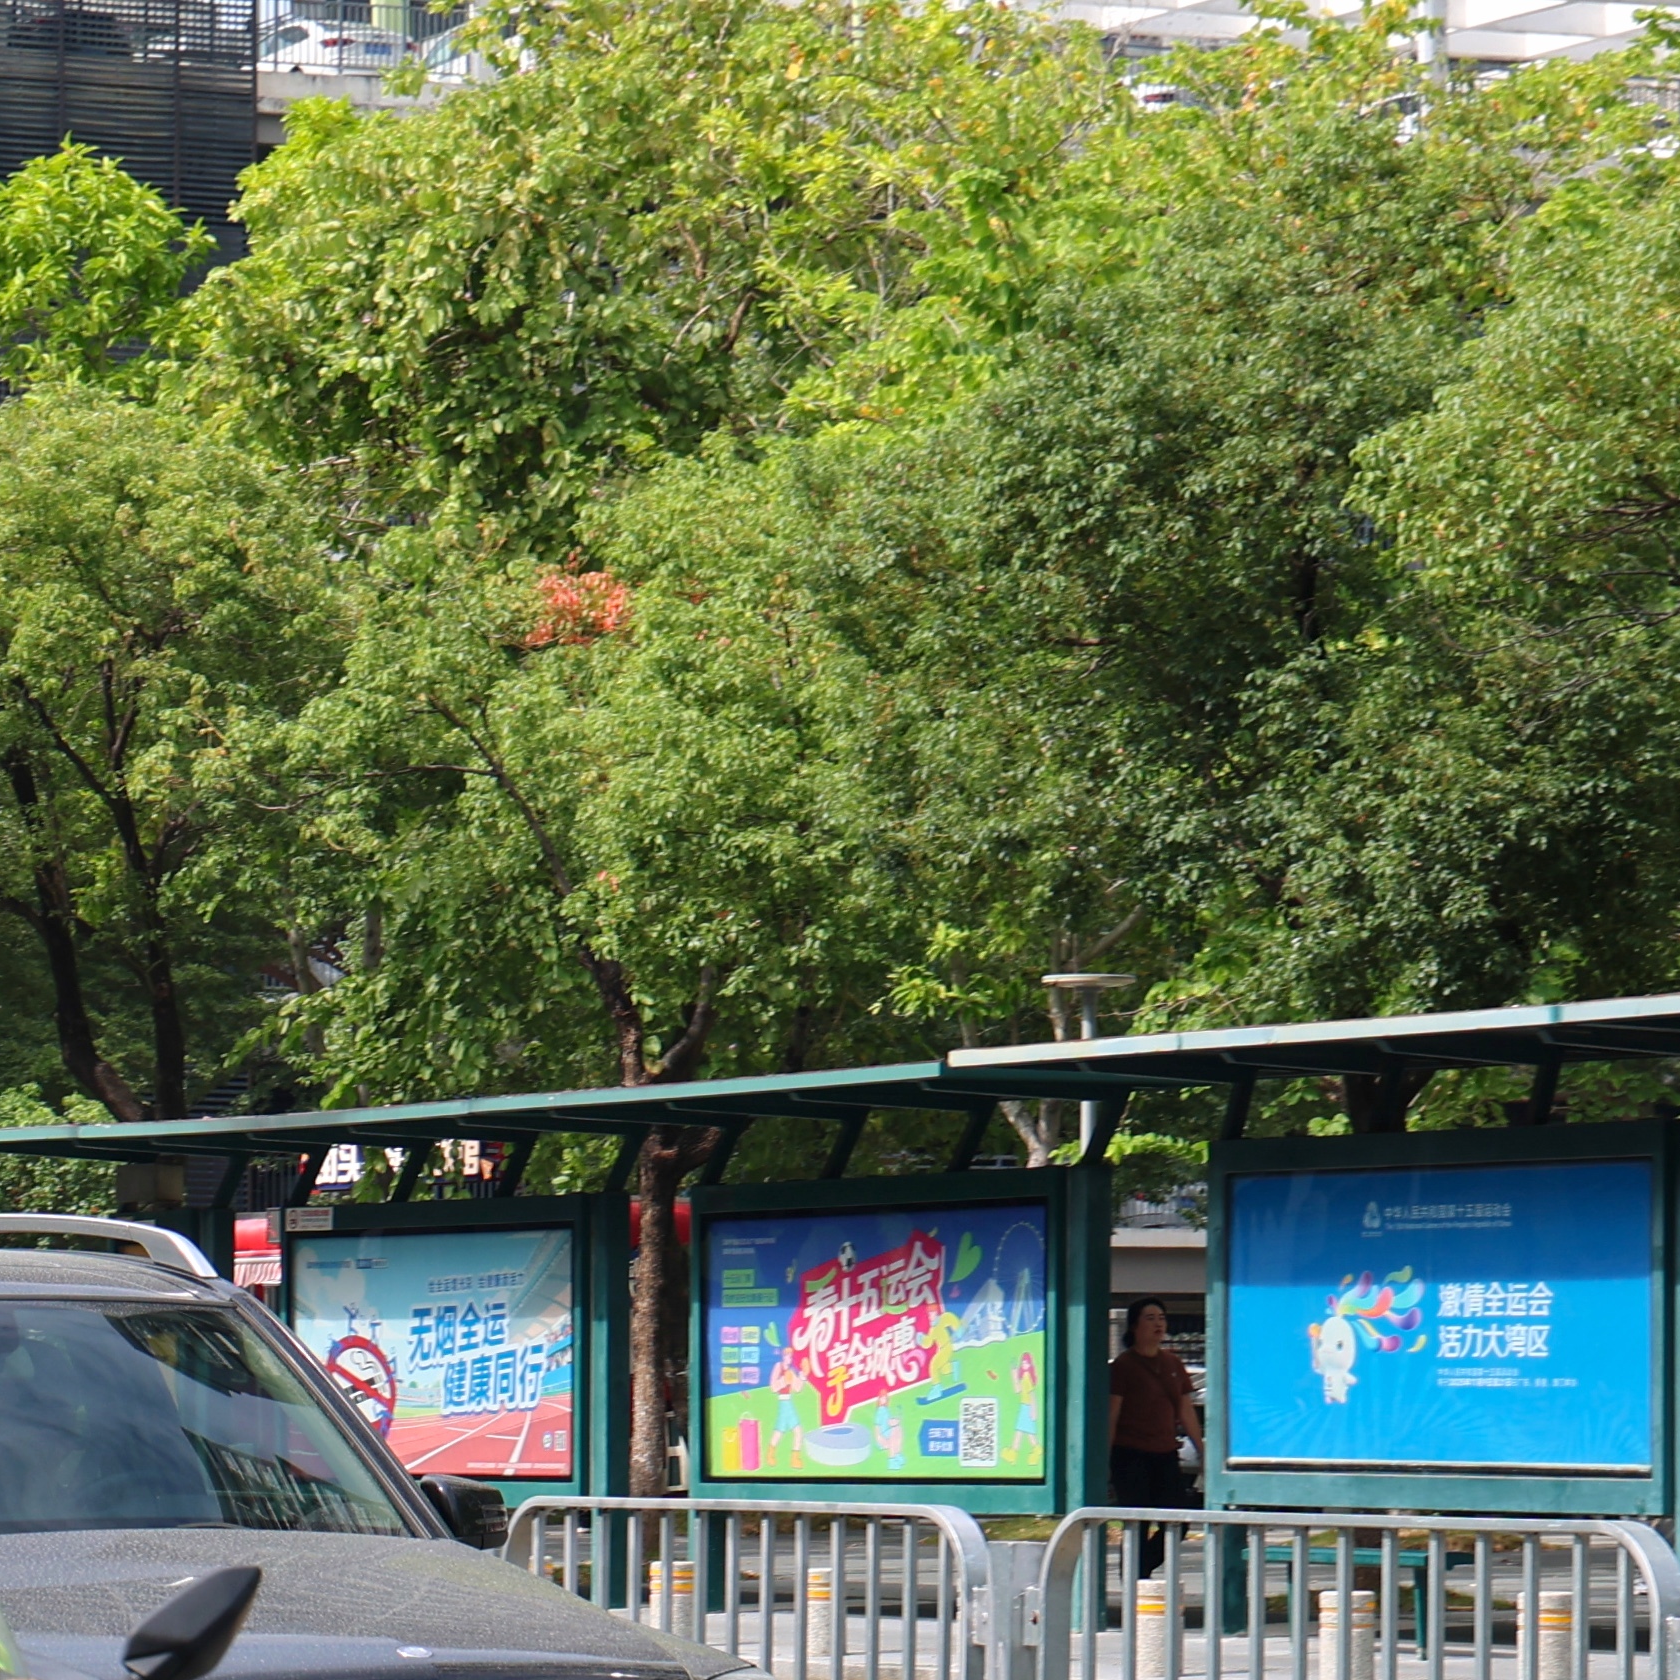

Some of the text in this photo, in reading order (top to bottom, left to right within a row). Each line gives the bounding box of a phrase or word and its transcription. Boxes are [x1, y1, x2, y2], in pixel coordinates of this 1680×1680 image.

[1437, 1281, 1554, 1317] 激情全运会
[408, 1301, 507, 1364] 无烟全运
[1437, 1323, 1551, 1358] 活力大湾区
[443, 1343, 545, 1407] 健康同行
